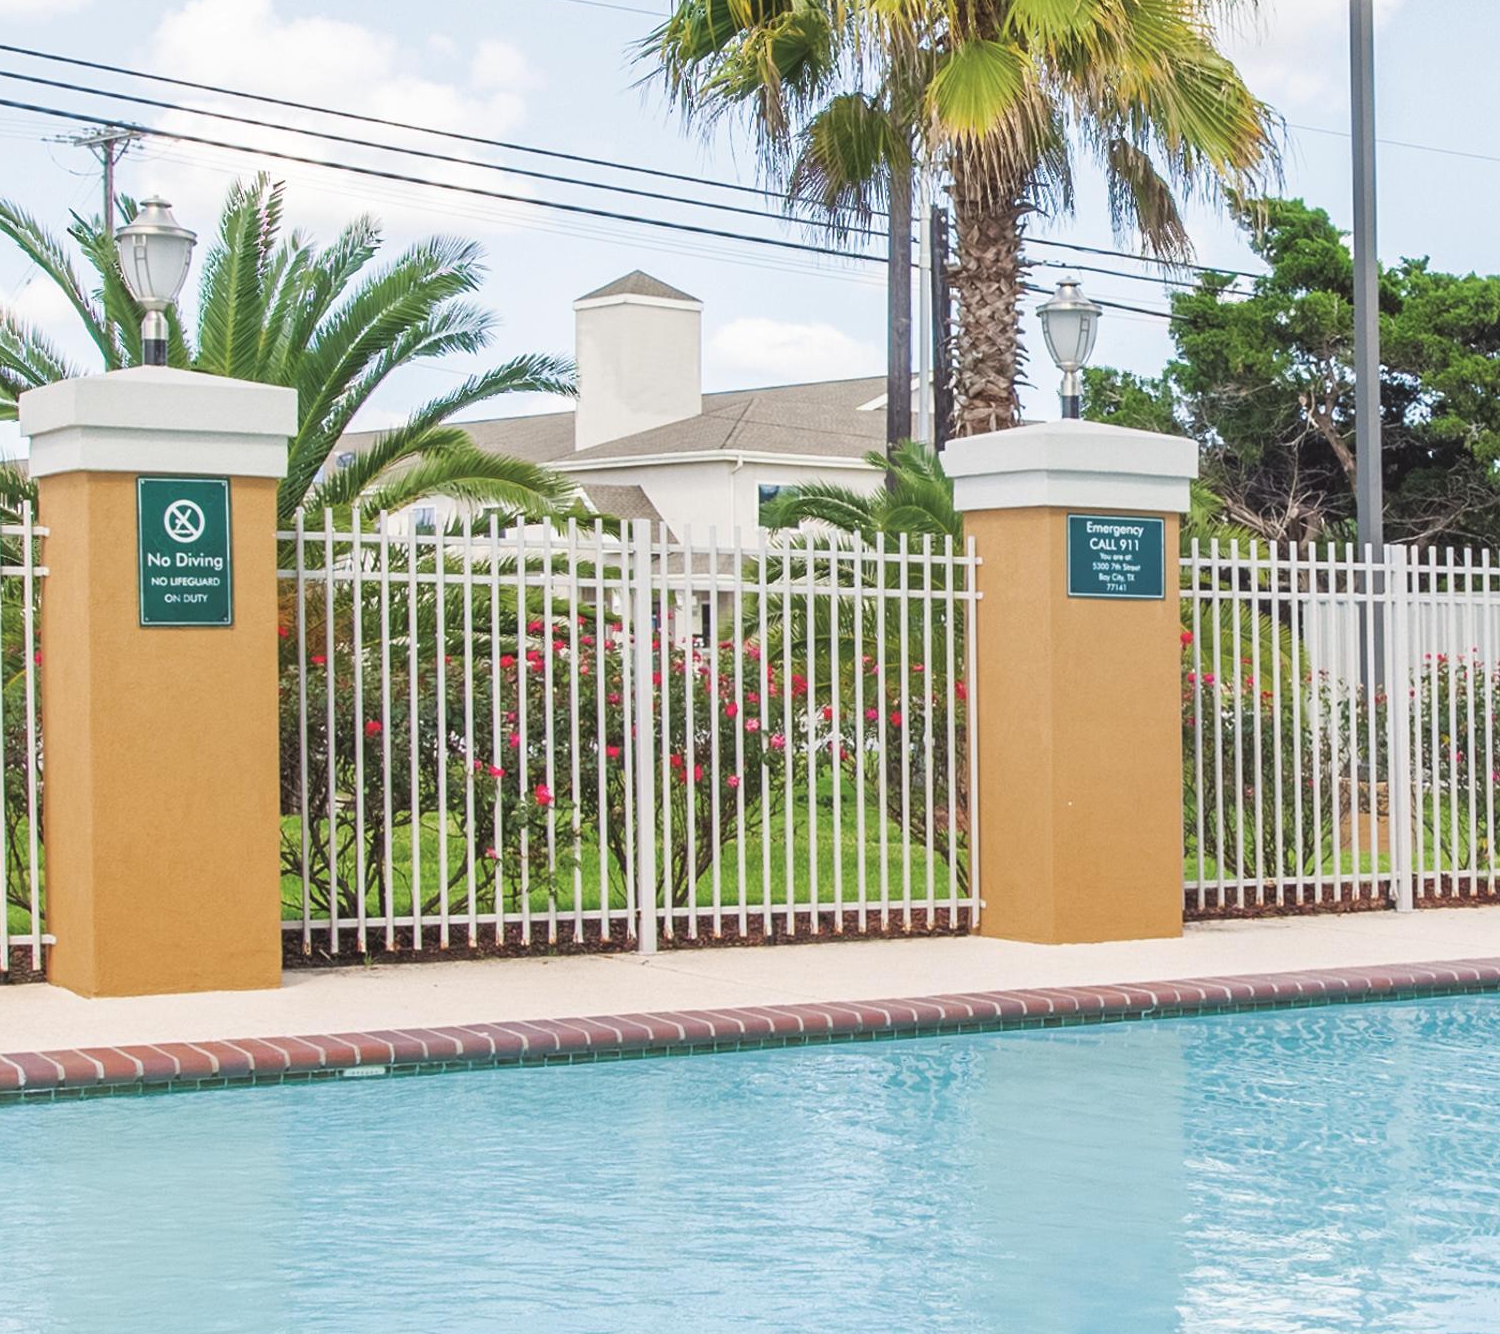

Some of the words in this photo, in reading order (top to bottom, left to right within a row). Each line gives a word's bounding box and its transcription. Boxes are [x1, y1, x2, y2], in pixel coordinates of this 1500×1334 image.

[1086, 521, 1144, 538] Emergency
[1089, 538, 1117, 551] CALL
[1120, 539, 1139, 551] 911
[147, 553, 171, 567] No
[176, 552, 223, 570] Diving
[1100, 553, 1111, 561] You
[1092, 562, 1110, 571] 5300
[1111, 562, 1121, 571] 7th
[1123, 563, 1141, 572] Street
[151, 577, 168, 586] NO
[170, 577, 220, 586] LIFEGUARD
[1099, 573, 1110, 582] Bay
[1127, 573, 1135, 581] TX
[164, 594, 181, 603] ON
[183, 594, 209, 603] DUTY
